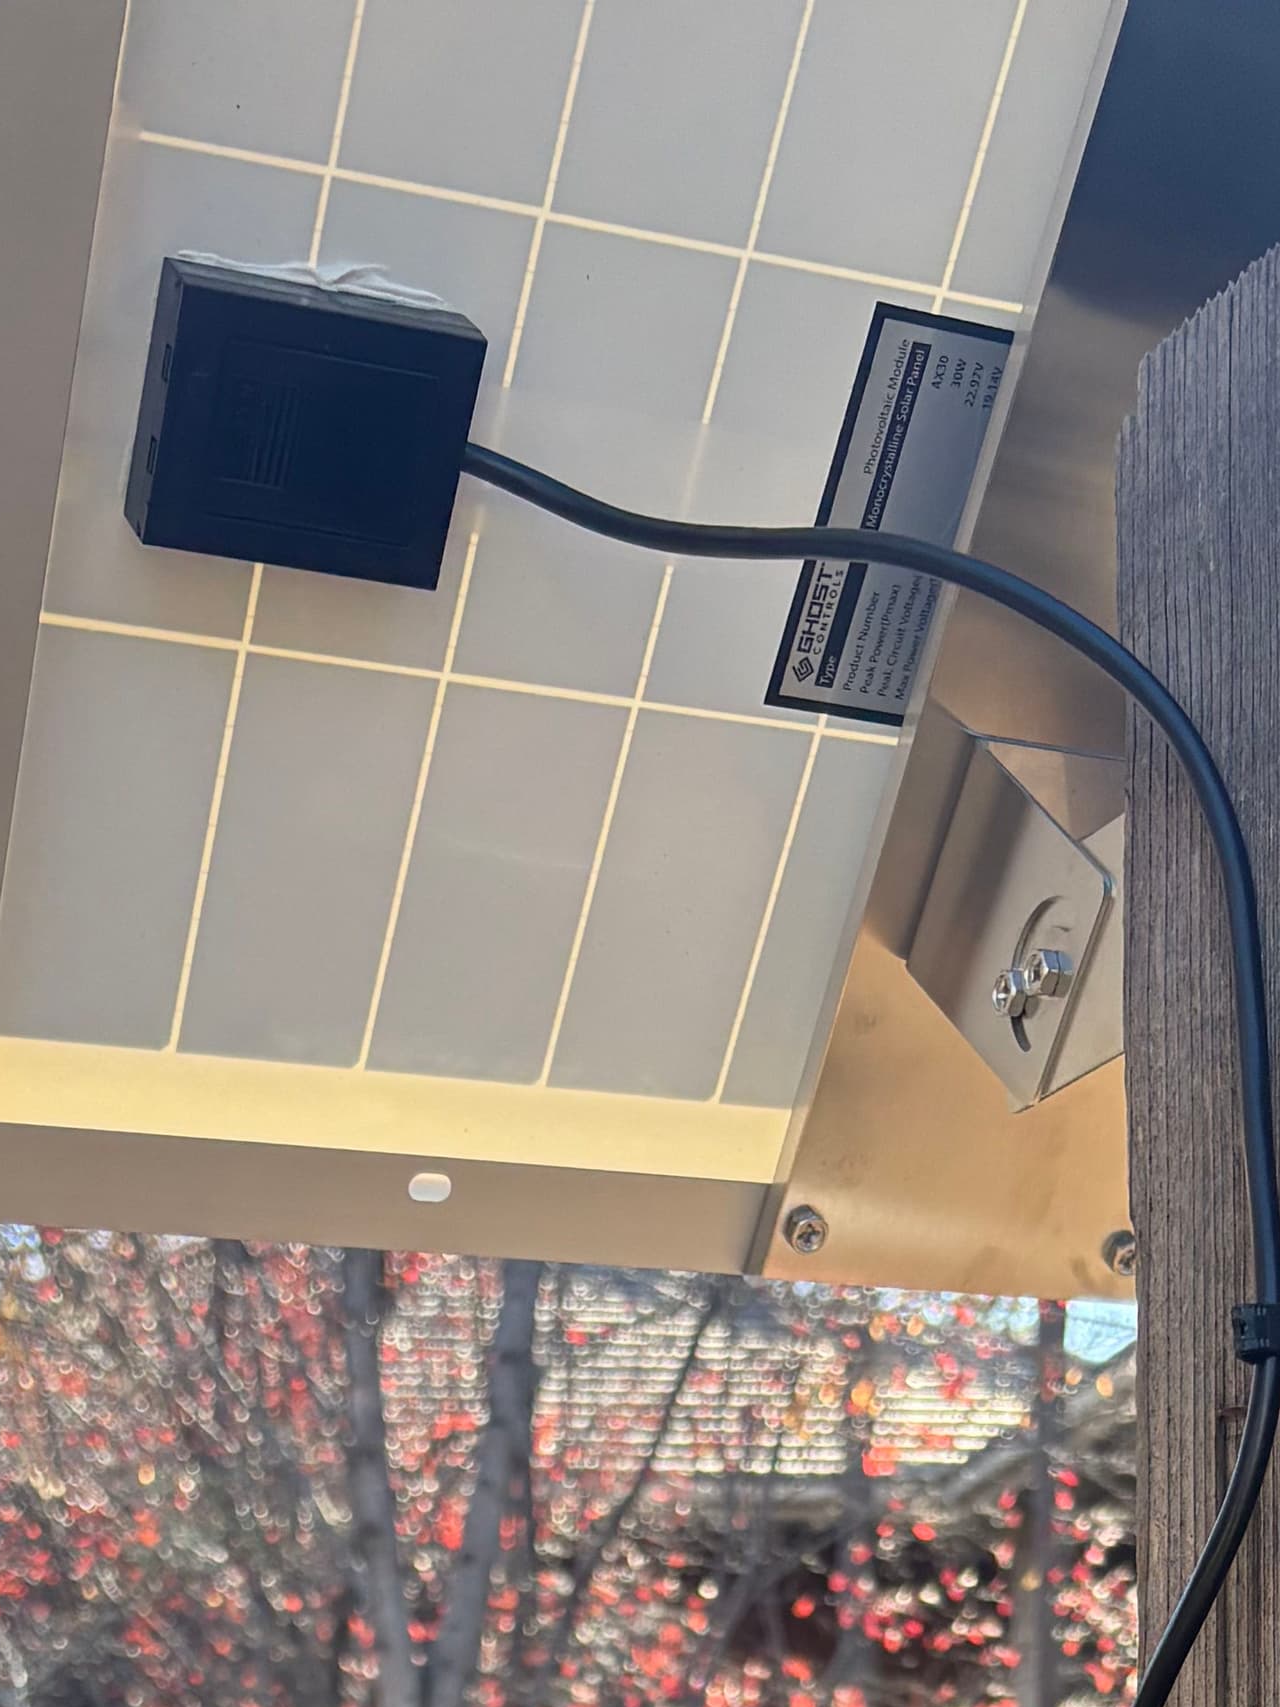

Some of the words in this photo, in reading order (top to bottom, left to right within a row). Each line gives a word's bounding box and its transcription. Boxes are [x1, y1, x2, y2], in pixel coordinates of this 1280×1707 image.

[932, 355, 950, 389] AX30
[951, 359, 968, 388] 30W
[964, 362, 985, 407] 22.97V
[863, 393, 894, 474] Photovoltaic
[888, 338, 910, 389] Module
[866, 424, 905, 528] Monocrystalline
[897, 388, 914, 422] Solar
[907, 350, 925, 386] Panel
[813, 570, 843, 654] CONTROLS
[843, 644, 864, 691] Product
[860, 591, 880, 642] Number
[860, 665, 875, 694] Peak
[870, 584, 901, 663] Power(Pmax)
[821, 655, 835, 685] Type
[887, 628, 904, 666] Circuit
[895, 675, 910, 699] Max
[904, 636, 921, 672] Power
